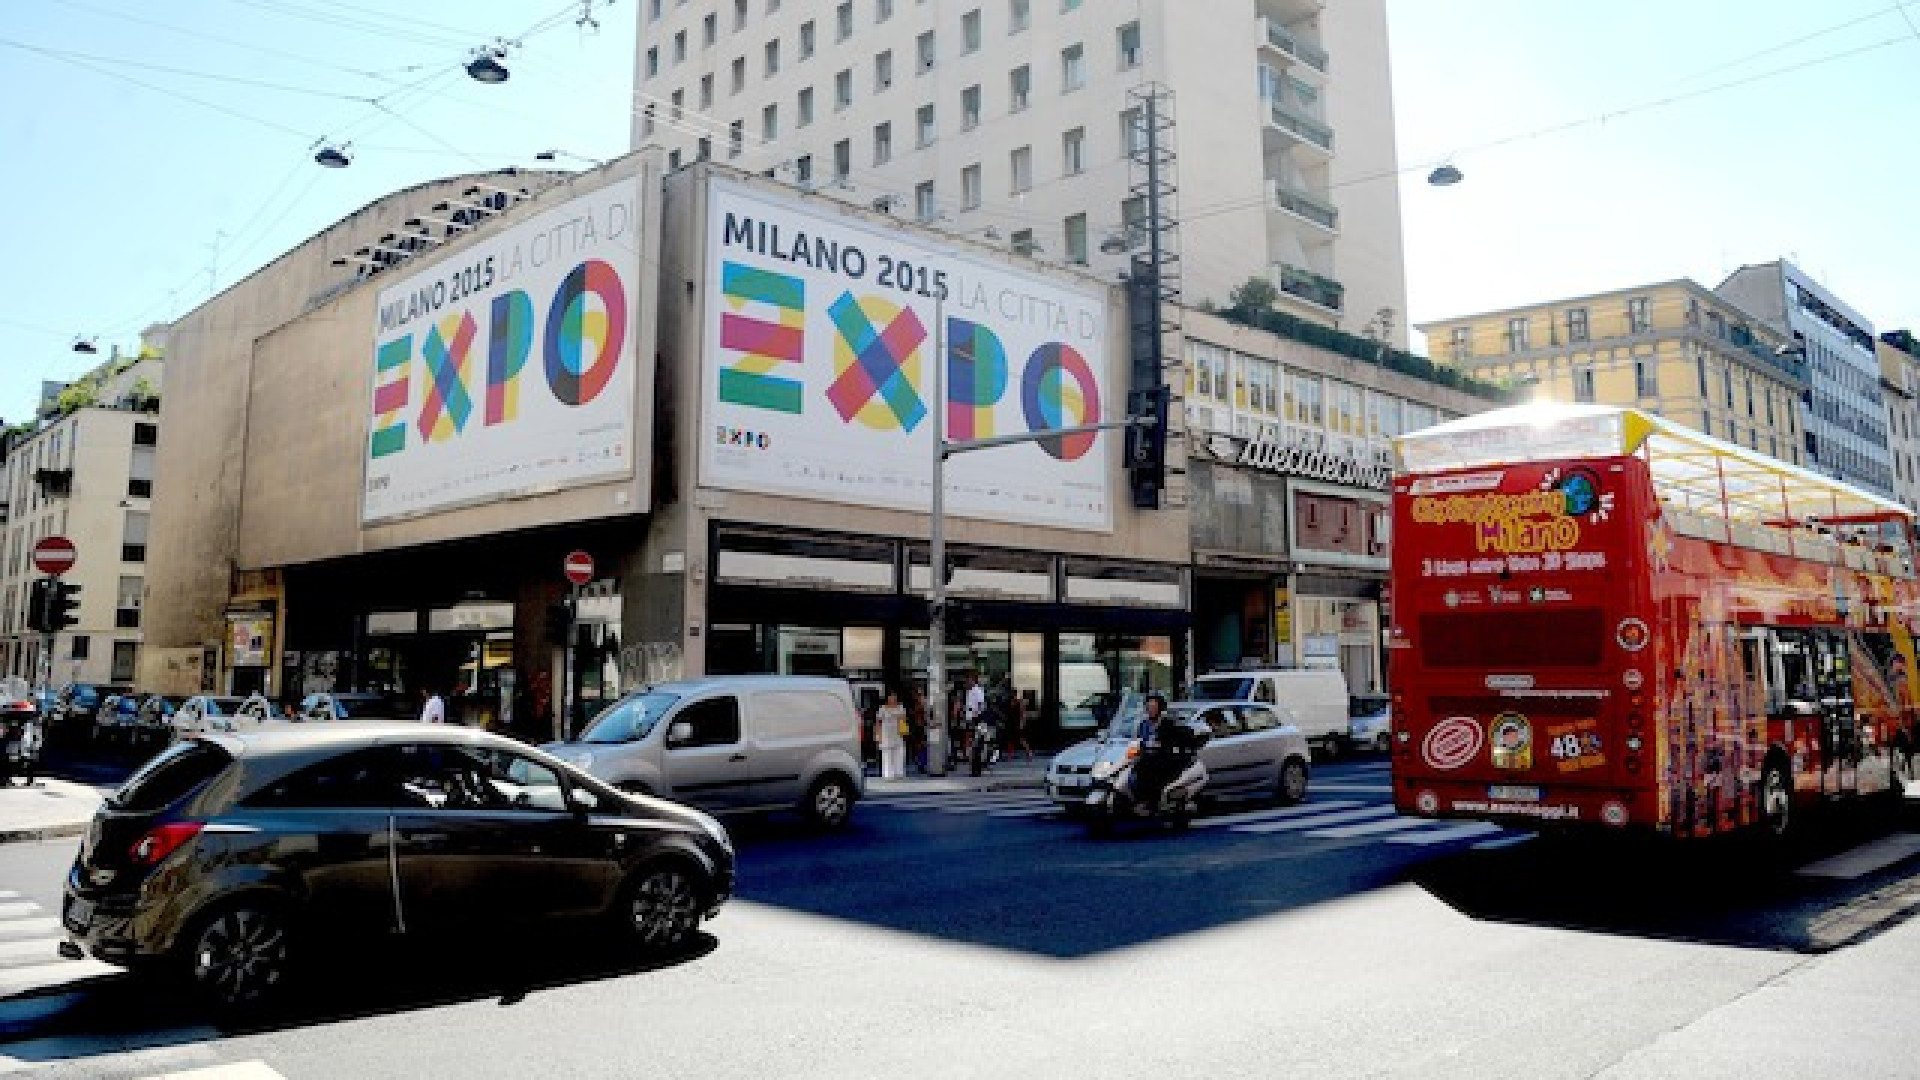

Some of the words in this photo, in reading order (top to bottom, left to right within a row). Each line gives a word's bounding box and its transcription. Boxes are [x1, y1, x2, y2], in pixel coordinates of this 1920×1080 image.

[379, 280, 445, 334] MILANO
[450, 255, 496, 303] 2015
[500, 242, 523, 284] LA
[723, 212, 866, 280] MILANO
[877, 254, 949, 301] 2015
[958, 276, 990, 313] LA
[371, 257, 628, 459] EXPO
[719, 260, 1101, 463] EXPO
[716, 425, 771, 451] EXPO
[1476, 515, 1581, 553] Milano
[1550, 734, 1582, 758] 48
